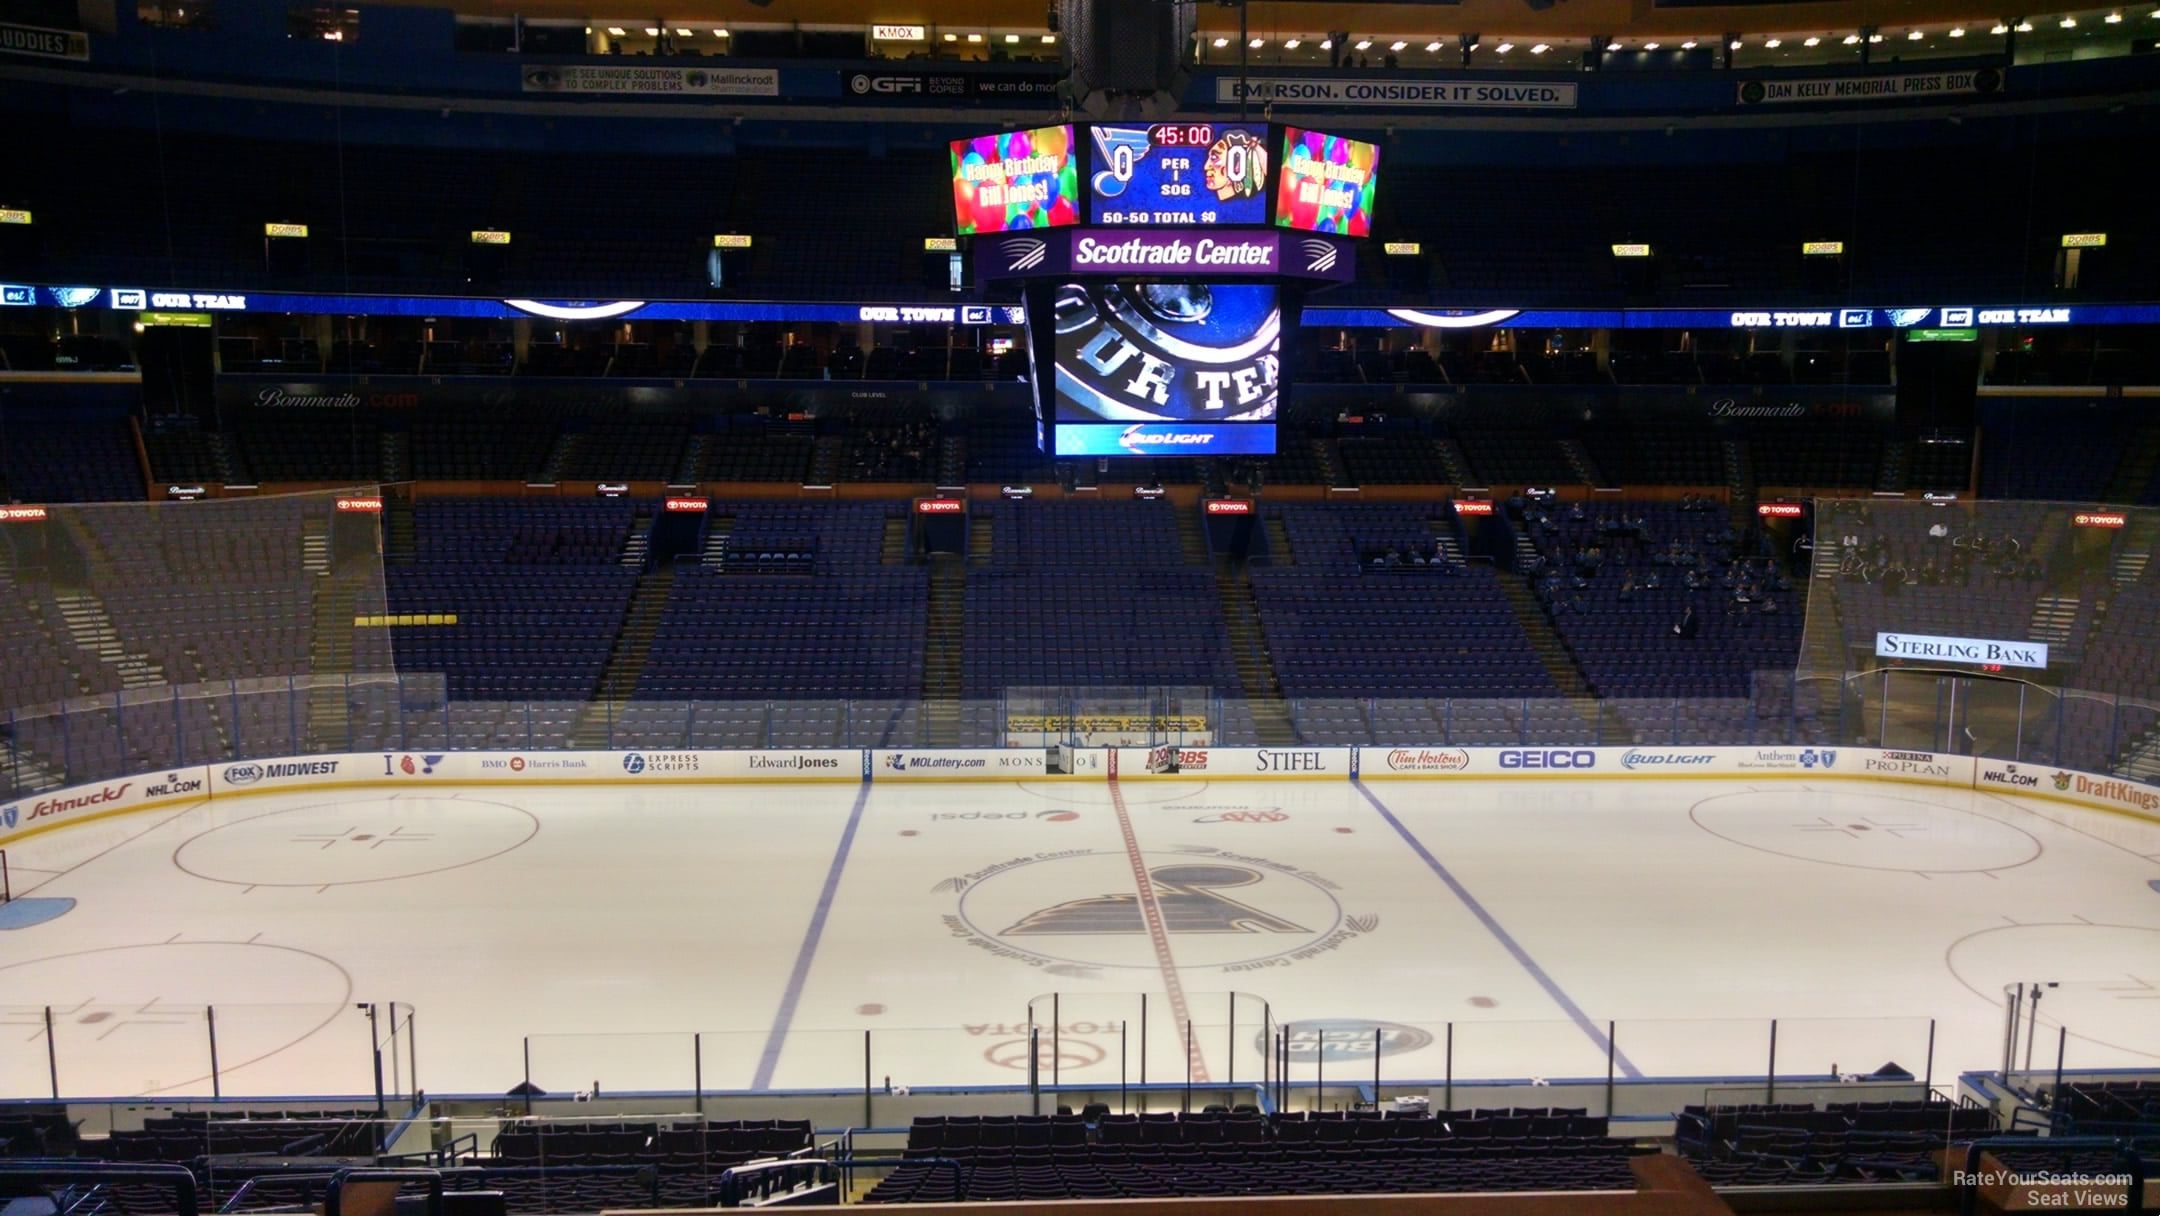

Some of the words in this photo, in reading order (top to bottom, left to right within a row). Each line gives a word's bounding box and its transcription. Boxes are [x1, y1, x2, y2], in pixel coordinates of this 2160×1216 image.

[879, 28, 913, 38] KMOX
[0, 28, 64, 53] UDDIES
[600, 71, 632, 80] UNIQUE
[634, 71, 682, 80] SOLUTIONS
[711, 74, 773, 85] Mallinckrodt
[565, 80, 577, 89] TO
[582, 80, 626, 90] COMPLEX
[631, 81, 682, 90] PROBLEMS
[929, 85, 964, 93] COPIES
[979, 82, 995, 91] we
[997, 82, 1015, 91] can
[1018, 81, 1032, 91] do
[1035, 83, 1057, 92] mor
[1232, 83, 1338, 99] EMRSON.
[1345, 84, 1446, 100] CONSIDER
[1453, 86, 1473, 100] IT
[1768, 84, 1791, 99] DAN
[1796, 82, 1831, 97] KELLY
[1834, 80, 1897, 96] MEMORIAL
[1903, 77, 1941, 92] PRESS
[1946, 75, 1972, 90] BOX
[1155, 127, 1211, 144] 45:00
[1114, 145, 1133, 181] 0
[1161, 158, 1190, 170] PER
[1227, 145, 1247, 181] 0
[1160, 184, 1191, 196] SOG
[1102, 212, 1149, 223] 50-50
[1153, 212, 1196, 223] TOTAL
[1201, 211, 1216, 223] $0
[1076, 237, 1192, 264] Scottrade
[152, 293, 192, 308] OUR
[193, 294, 246, 309] TEAM
[860, 307, 899, 320] OUR
[900, 307, 955, 321] TOWN
[1731, 312, 1772, 326] OUR
[1773, 312, 1832, 326] TOWN
[1978, 310, 2016, 324] OUR
[2018, 309, 2070, 323] TEAM
[1195, 354, 1280, 410] TEA
[9, 509, 46, 518] TOYOTA
[1771, 506, 1800, 514] TOYOTA
[2089, 516, 2124, 525] TOYOTA
[1884, 635, 1980, 659] STERLING
[1986, 644, 2038, 662] BANK
[648, 754, 699, 762] EXPRESS
[1256, 750, 1326, 771] STIFEL
[1395, 750, 1416, 763] Tim
[1417, 750, 1461, 763] Hortons
[1499, 750, 1595, 768] GEICO
[1755, 750, 1796, 761] Anthem
[1892, 752, 1932, 762] PURINA
[266, 761, 339, 778] MIDWEST
[481, 760, 507, 768] BMO
[528, 759, 560, 768] Harris
[561, 759, 587, 768] Bank
[649, 762, 699, 771] SCRIPTS
[910, 756, 986, 770] MOLottery.com
[1865, 759, 1898, 771] PRO
[1900, 760, 1950, 776] PLAN
[232, 767, 255, 778] FOX
[1983, 771, 2038, 787] NHL.COM
[145, 779, 202, 798] NHL.COM
[2076, 775, 2160, 810] DraftKings
[26, 783, 133, 821] Schnucks
[931, 811, 1027, 821] pepsi
[961, 1021, 1123, 1036] TOYOTA
